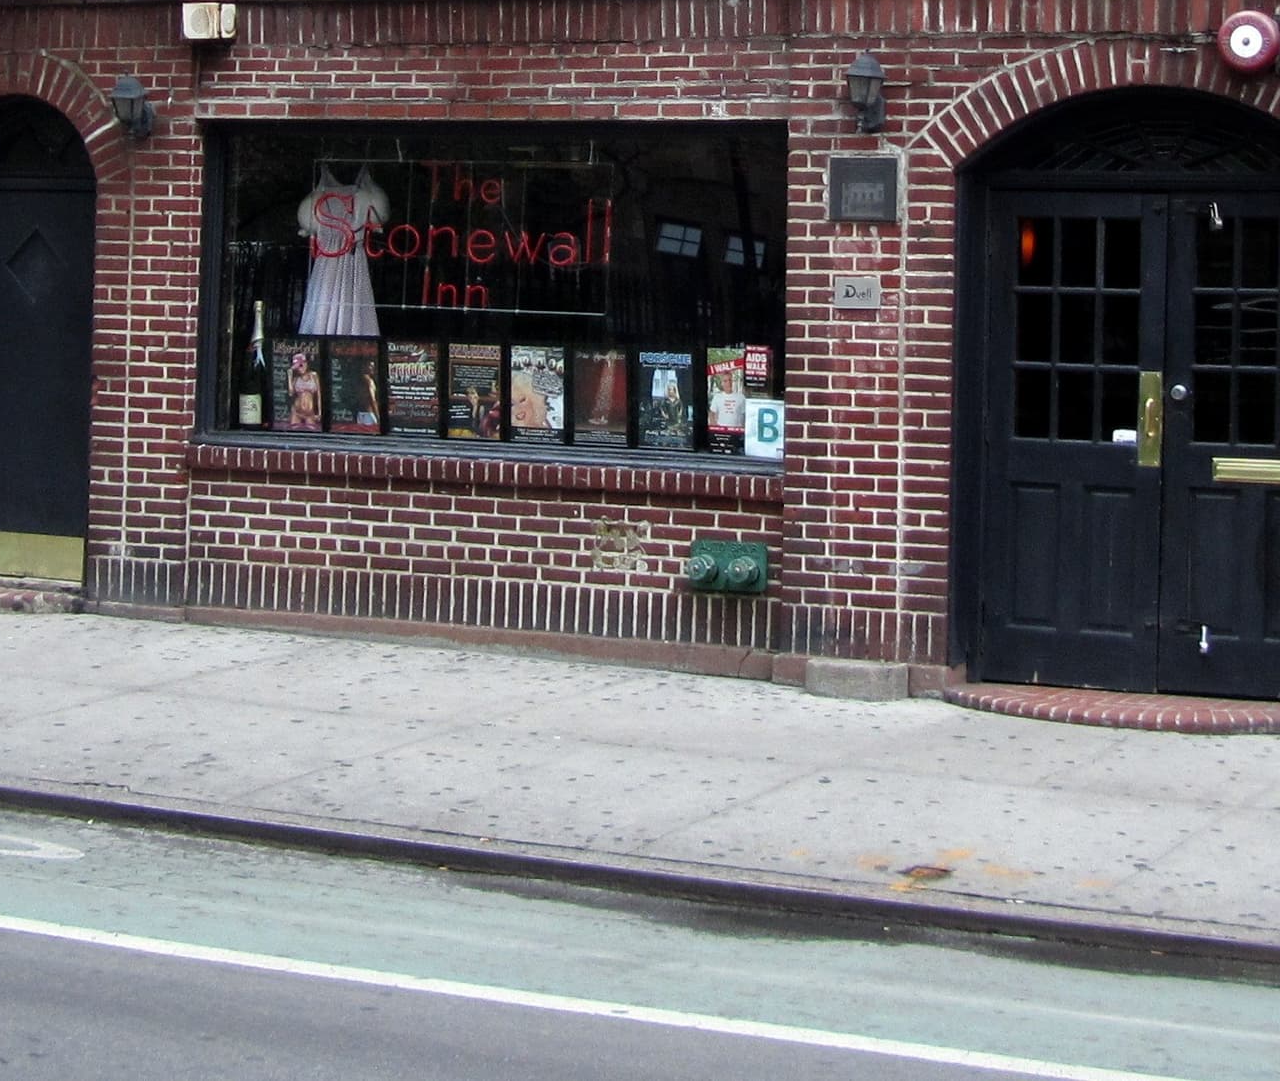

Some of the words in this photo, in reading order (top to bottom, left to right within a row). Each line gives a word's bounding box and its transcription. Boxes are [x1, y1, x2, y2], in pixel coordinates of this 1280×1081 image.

[420, 160, 506, 205] The
[310, 191, 614, 267] Stonewall
[422, 266, 489, 309] Inn
[714, 360, 736, 374] WALK
[746, 352, 767, 362] AIDS
[746, 362, 767, 371] WALK
[757, 408, 779, 443] B
